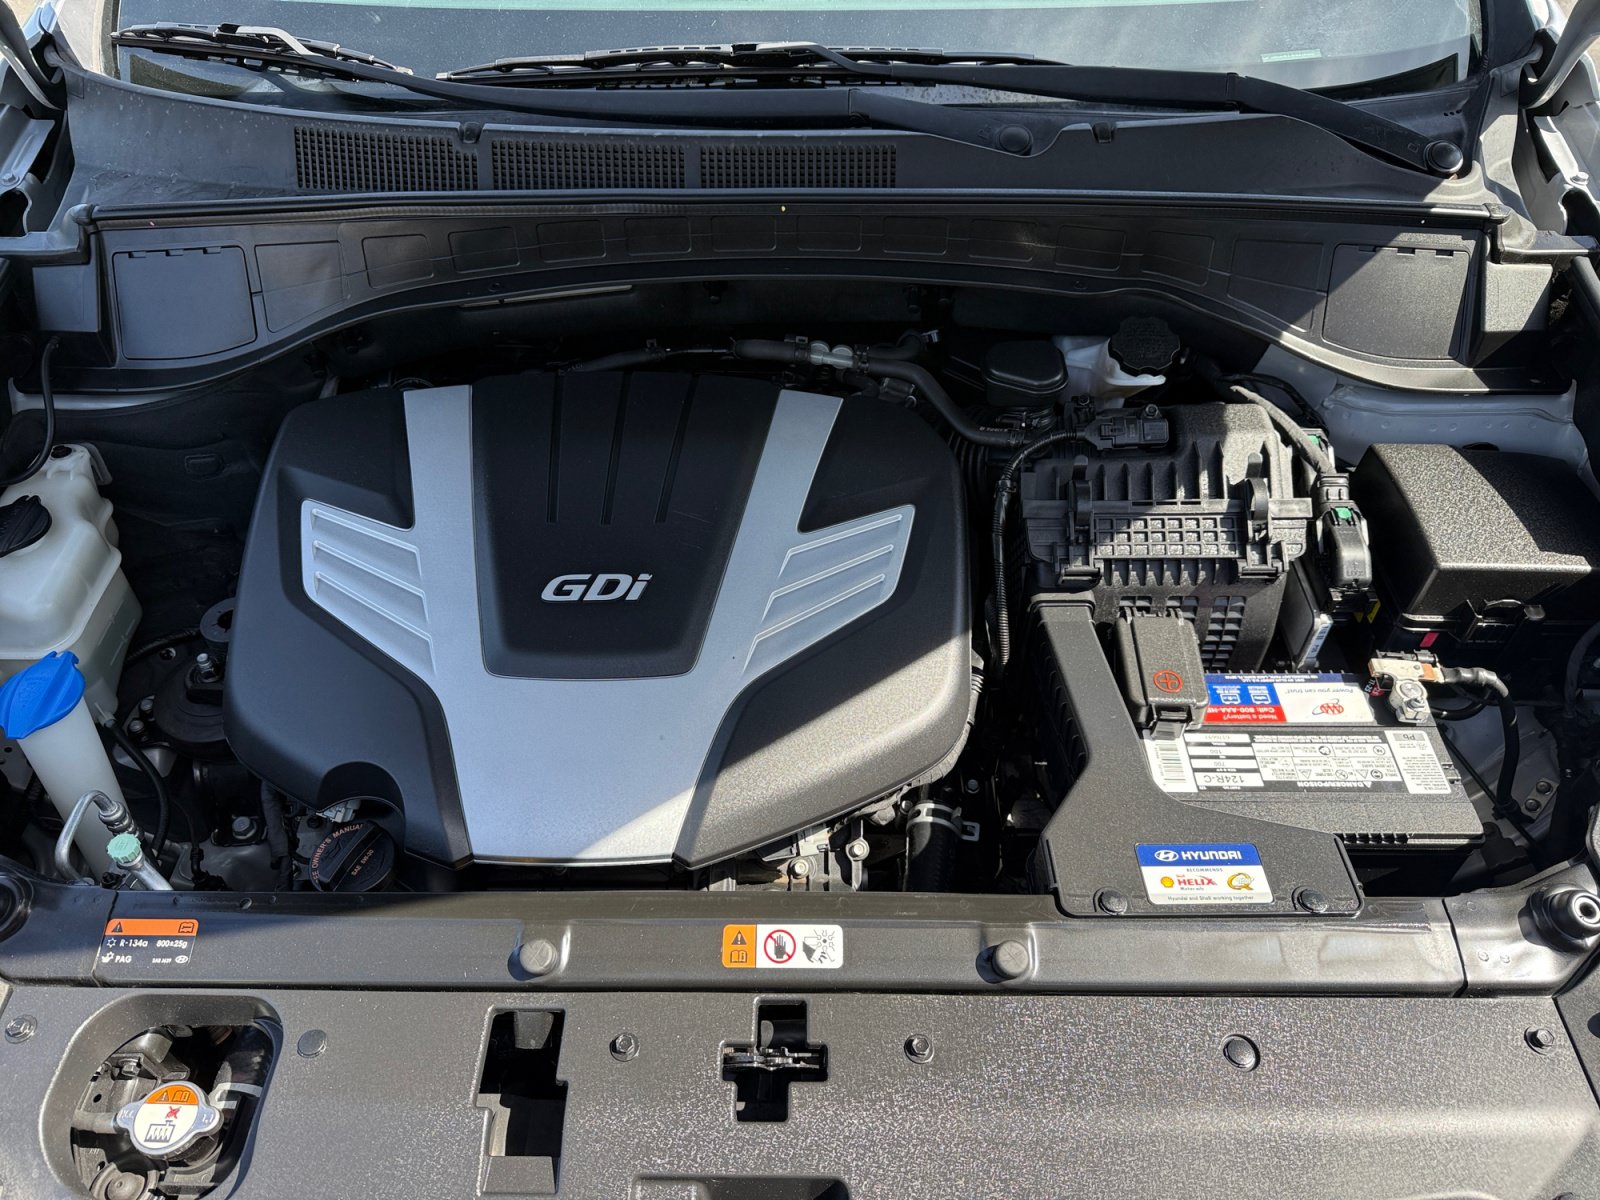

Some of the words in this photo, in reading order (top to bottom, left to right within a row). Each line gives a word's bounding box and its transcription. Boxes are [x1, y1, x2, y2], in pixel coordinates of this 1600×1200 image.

[541, 573, 653, 602] GDi
[1203, 775, 1245, 784] 124R-C
[1181, 850, 1243, 860] HYUNDAI
[1177, 878, 1215, 886] HELIX
[119, 939, 148, 947] R-134a
[115, 955, 132, 963] PAG
